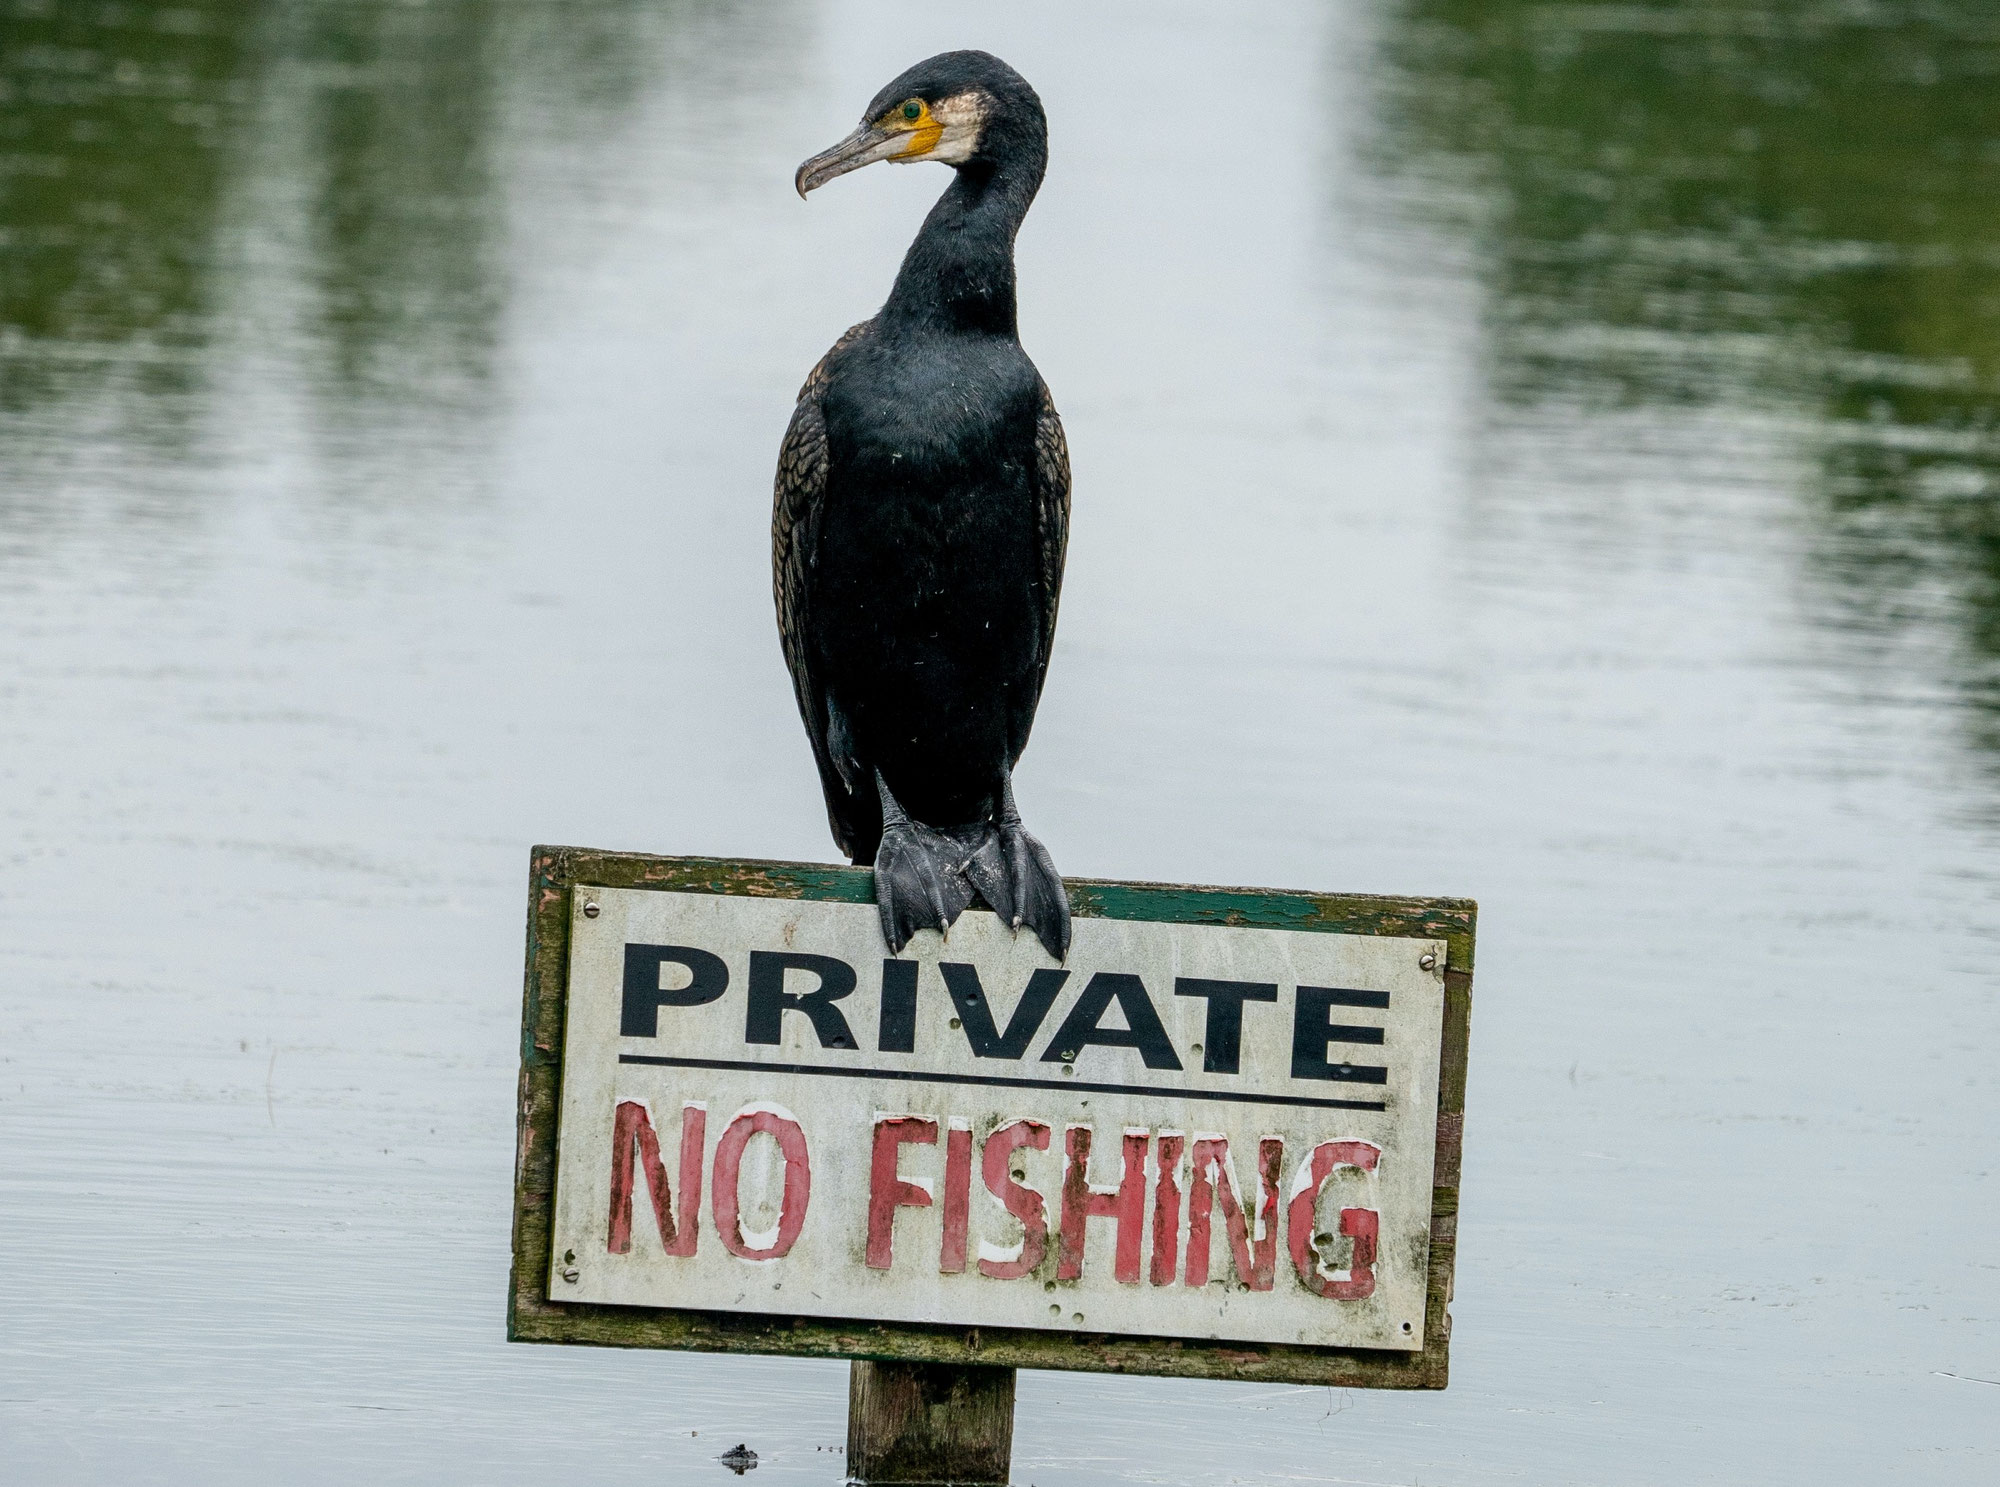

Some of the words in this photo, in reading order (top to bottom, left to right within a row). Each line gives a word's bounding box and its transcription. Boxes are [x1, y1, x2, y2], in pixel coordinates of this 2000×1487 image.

[620, 943, 1390, 1084] PRIVATE
[607, 1098, 811, 1263] NO
[865, 1112, 1382, 1300] FISHING
